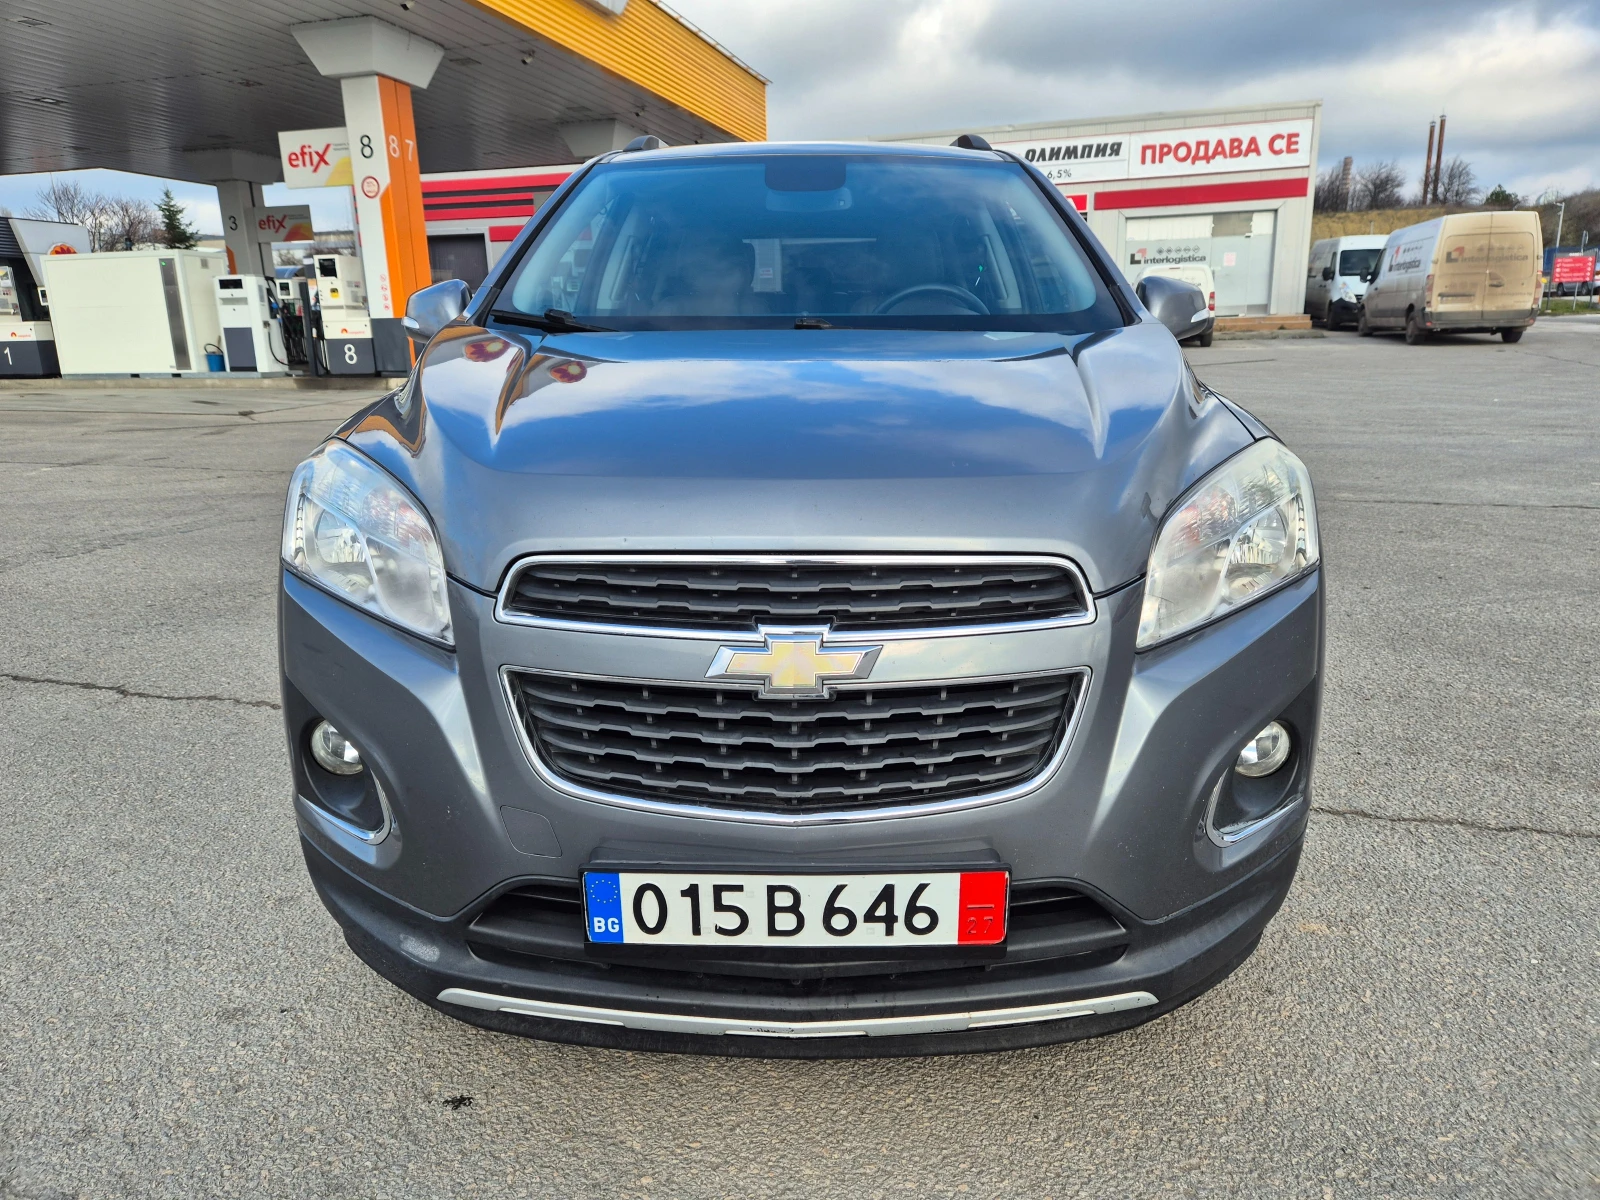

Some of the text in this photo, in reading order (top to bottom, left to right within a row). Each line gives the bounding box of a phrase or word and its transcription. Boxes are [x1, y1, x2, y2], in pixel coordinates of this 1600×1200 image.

[360, 134, 374, 159] 8
[388, 134, 400, 158] 8
[405, 139, 414, 161] 7
[1025, 142, 1122, 162] ОЛИМПИЯ
[1140, 132, 1300, 165] ПРОДАВА СЕ
[1046, 168, 1072, 179] 6,5%
[229, 215, 238, 231] 3
[1143, 254, 1207, 265] interlogistica
[4, 346, 12, 365] 1
[344, 344, 358, 364] 8
[593, 917, 620, 933] BG
